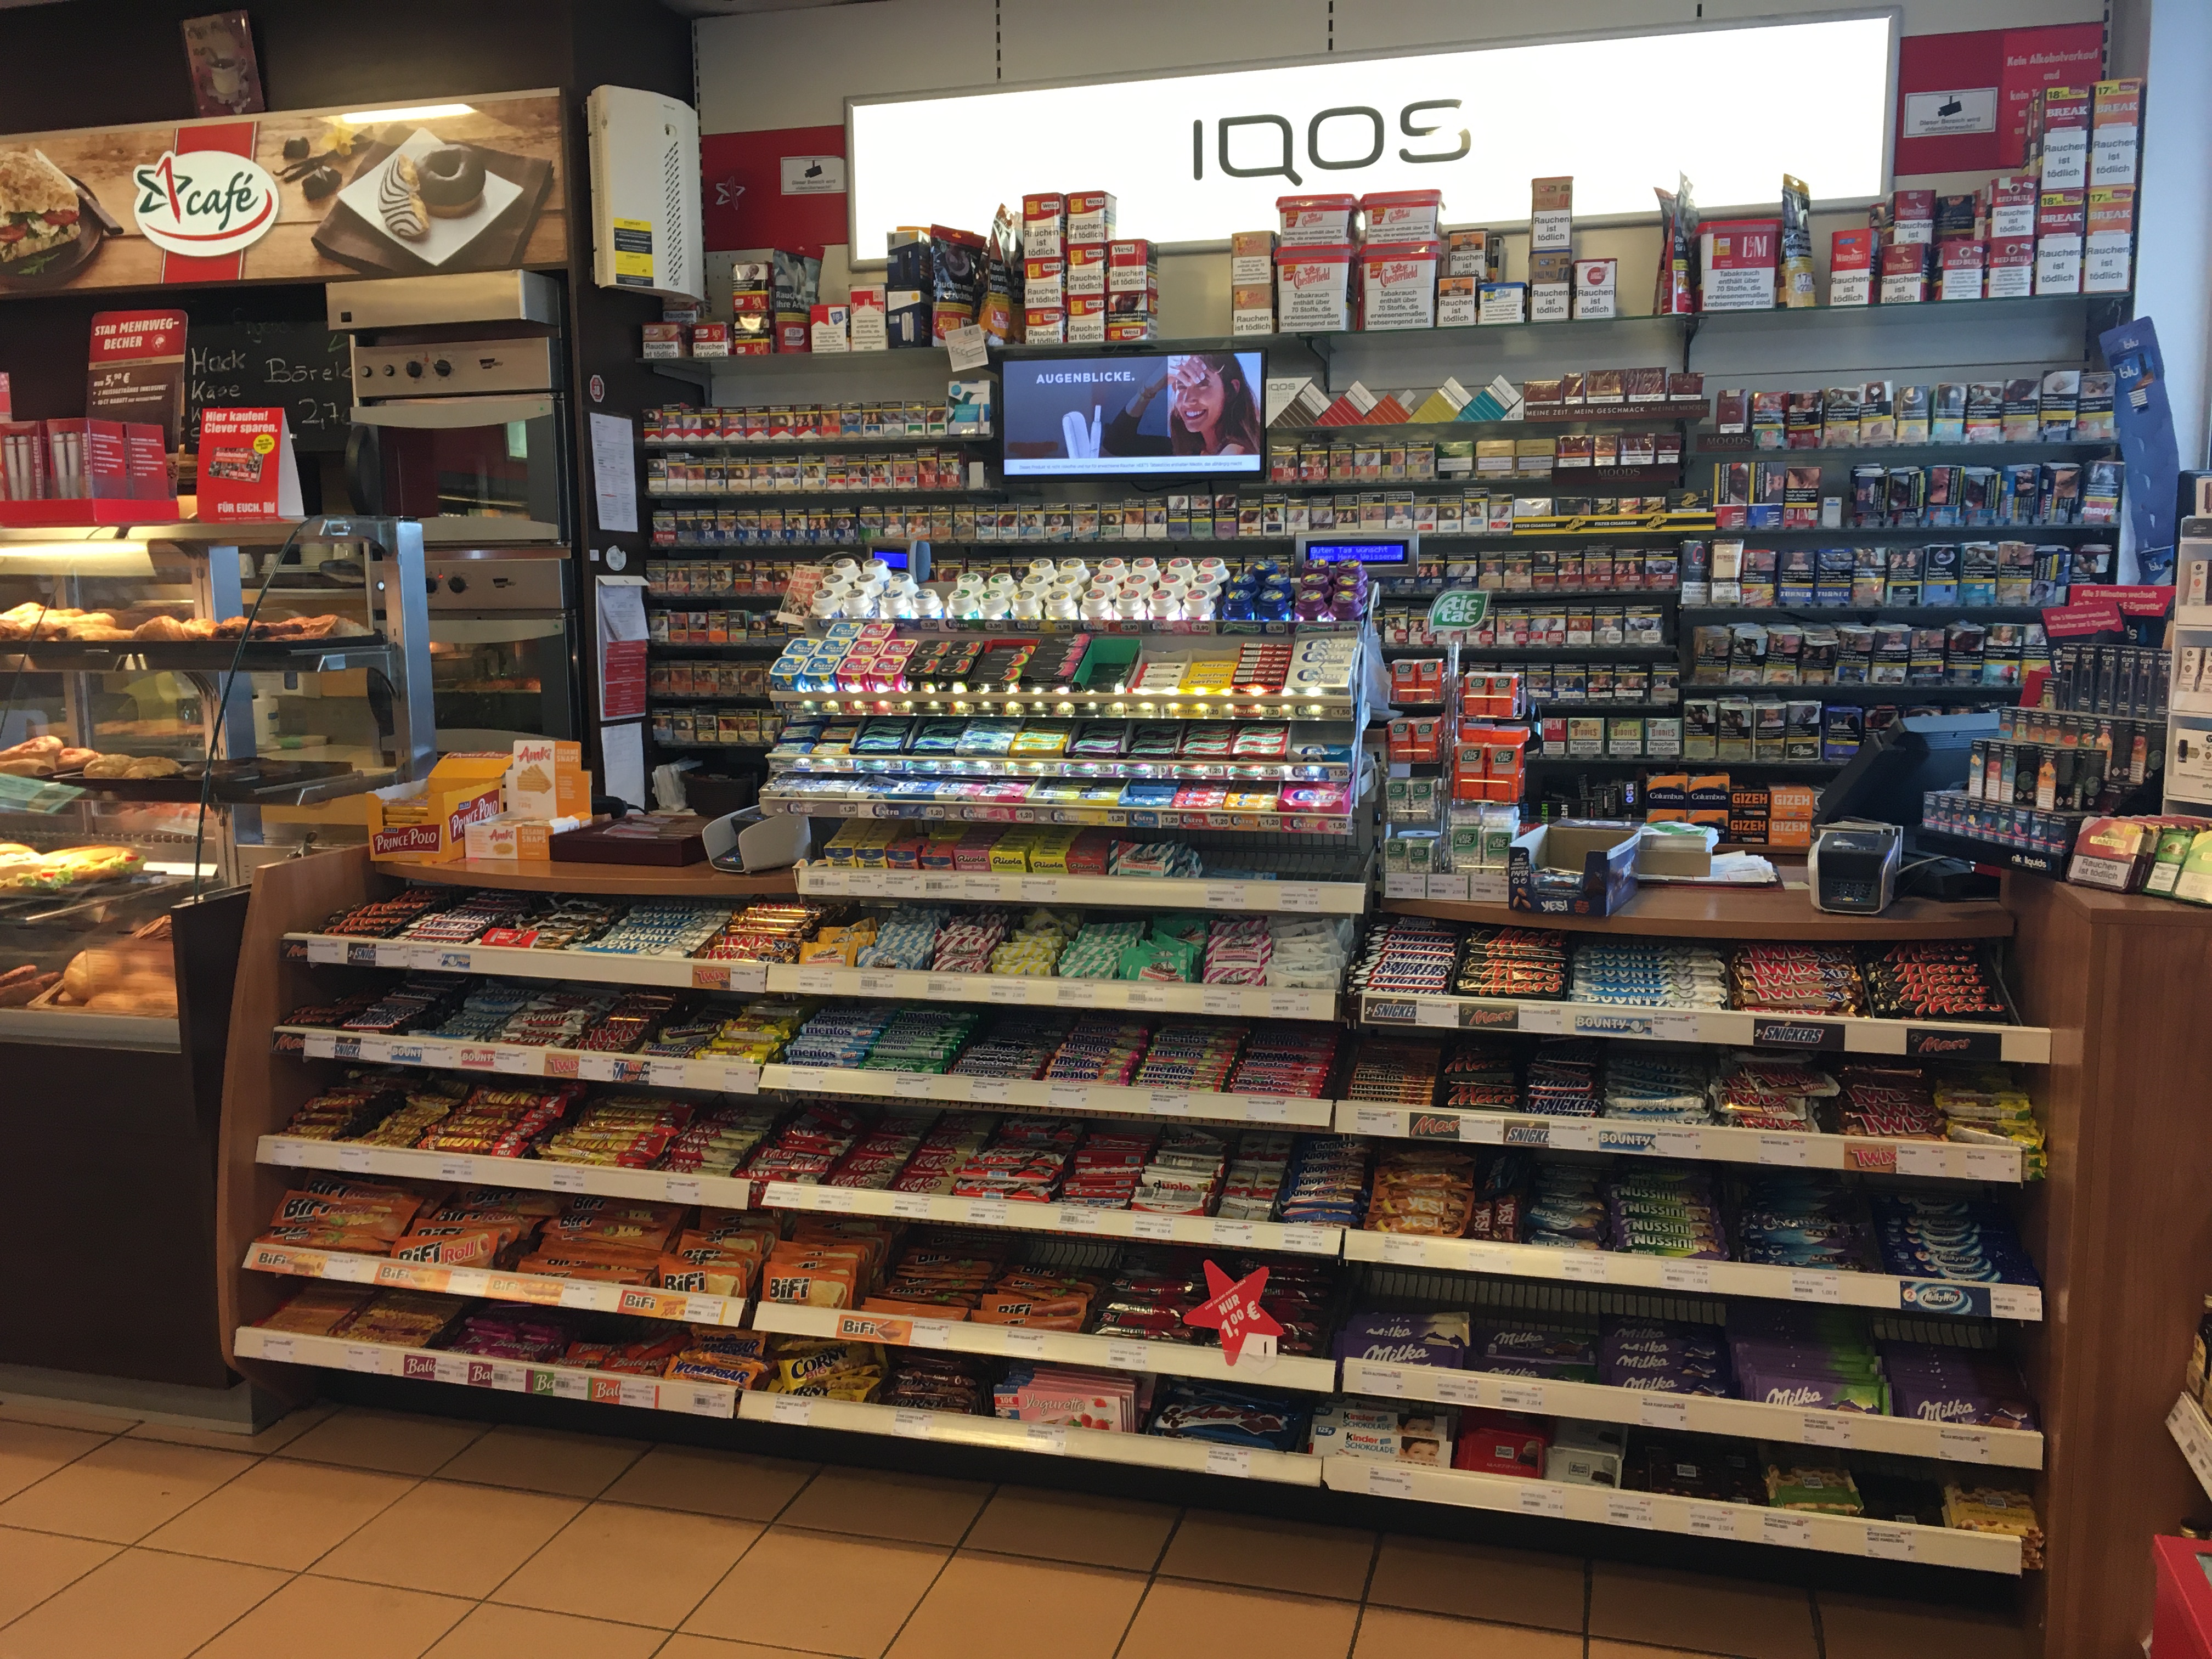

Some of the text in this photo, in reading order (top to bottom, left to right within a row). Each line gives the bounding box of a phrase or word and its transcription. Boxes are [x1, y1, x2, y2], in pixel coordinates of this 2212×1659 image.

[2007, 57, 2026, 66] Kein
[2044, 70, 2059, 80] und
[2046, 106, 2087, 117] BREAK
[1193, 99, 1471, 186] IQOS
[2045, 143, 2086, 153] Rauchen
[2047, 168, 2080, 178] tödlich
[186, 172, 258, 230] café
[1534, 216, 1569, 224] Rauchen
[1025, 229, 1059, 238] Rauchen
[1538, 233, 1565, 241] tödlich
[1028, 248, 1055, 256] tödlich
[1742, 235, 1768, 258] L&M
[1836, 252, 1863, 263] Winston
[1948, 258, 1960, 267] RED
[1112, 269, 1143, 278] Rauchen
[1294, 267, 1330, 290] Chesterfield
[1831, 274, 1870, 285] Rauchen
[1120, 278, 1146, 286] tödlich
[1843, 285, 1854, 294] ist
[1833, 292, 1864, 303] tödlich
[1300, 305, 1319, 313] Stoffe,
[1284, 312, 1339, 320] erwiesenermaßen
[95, 318, 179, 336] STAR MEHRWEG-
[1245, 323, 1271, 331] tödlich
[1281, 319, 1325, 329] krebserregend
[104, 336, 143, 350] BECHER
[2119, 364, 2138, 379] blu
[1036, 371, 1136, 385] AUGENBLICKE.
[1596, 406, 1646, 415] GESCHMACK.
[1679, 403, 1709, 411] MOODS
[205, 410, 268, 422] Hier kaufen!
[205, 422, 278, 435] Clever sparen.
[1598, 467, 1640, 478] MOODS
[218, 503, 234, 514] FÜR
[236, 503, 262, 514] EUCH.
[2100, 590, 2127, 599] Minuten
[1450, 595, 1478, 612] tic
[1442, 607, 1476, 623] tac
[1574, 728, 1598, 737] BIDDIES
[517, 746, 552, 763] Amki
[1626, 783, 1634, 803] OCB
[1650, 792, 1684, 800] Columbus
[1732, 793, 1768, 804] GIZEH
[1774, 794, 1810, 805] GIZEH
[375, 828, 437, 851] PRINCE POLO
[2092, 838, 2125, 848] PANTER
[957, 855, 986, 865] Ricola
[2011, 853, 2047, 870] nik liquids
[2082, 859, 2117, 871] Rauchen
[1511, 869, 1529, 878] PAPER
[2079, 865, 2118, 881] ist tödlich
[1541, 900, 1568, 912] YES!
[697, 969, 727, 983] Twix
[1380, 967, 1447, 979] SNICKERS
[1480, 979, 1562, 996] Mars
[1374, 1004, 1416, 1018] SNICKER
[1469, 1010, 1515, 1025] Mars
[1576, 1016, 1626, 1030] BOUNTY
[806, 1025, 851, 1036] mentos
[1763, 1026, 1823, 1043] SNICKERS
[1049, 1070, 1098, 1080] mentos
[1412, 1115, 1460, 1133] Mar
[1852, 1149, 1897, 1166] Twix
[899, 1176, 942, 1192] KitKat
[1153, 1180, 1192, 1192] duplo
[258, 1253, 286, 1265] BiFi
[399, 1242, 477, 1264] BiFi Roll
[770, 1277, 811, 1299] BiFi
[625, 1295, 657, 1310] BiFi
[1218, 1293, 1241, 1316] NUR
[1246, 1300, 1261, 1321] €
[1494, 1332, 1544, 1346] Milka
[791, 1346, 849, 1380] CORNY
[673, 1359, 751, 1383] WUNDERBAR
[805, 1367, 827, 1380] BIG
[1766, 1387, 1822, 1406] Milka
[1024, 1393, 1086, 1415] Yogurette
[1346, 1432, 1379, 1445] Kinder
[1345, 1442, 1395, 1454] SCHOKOLADE
